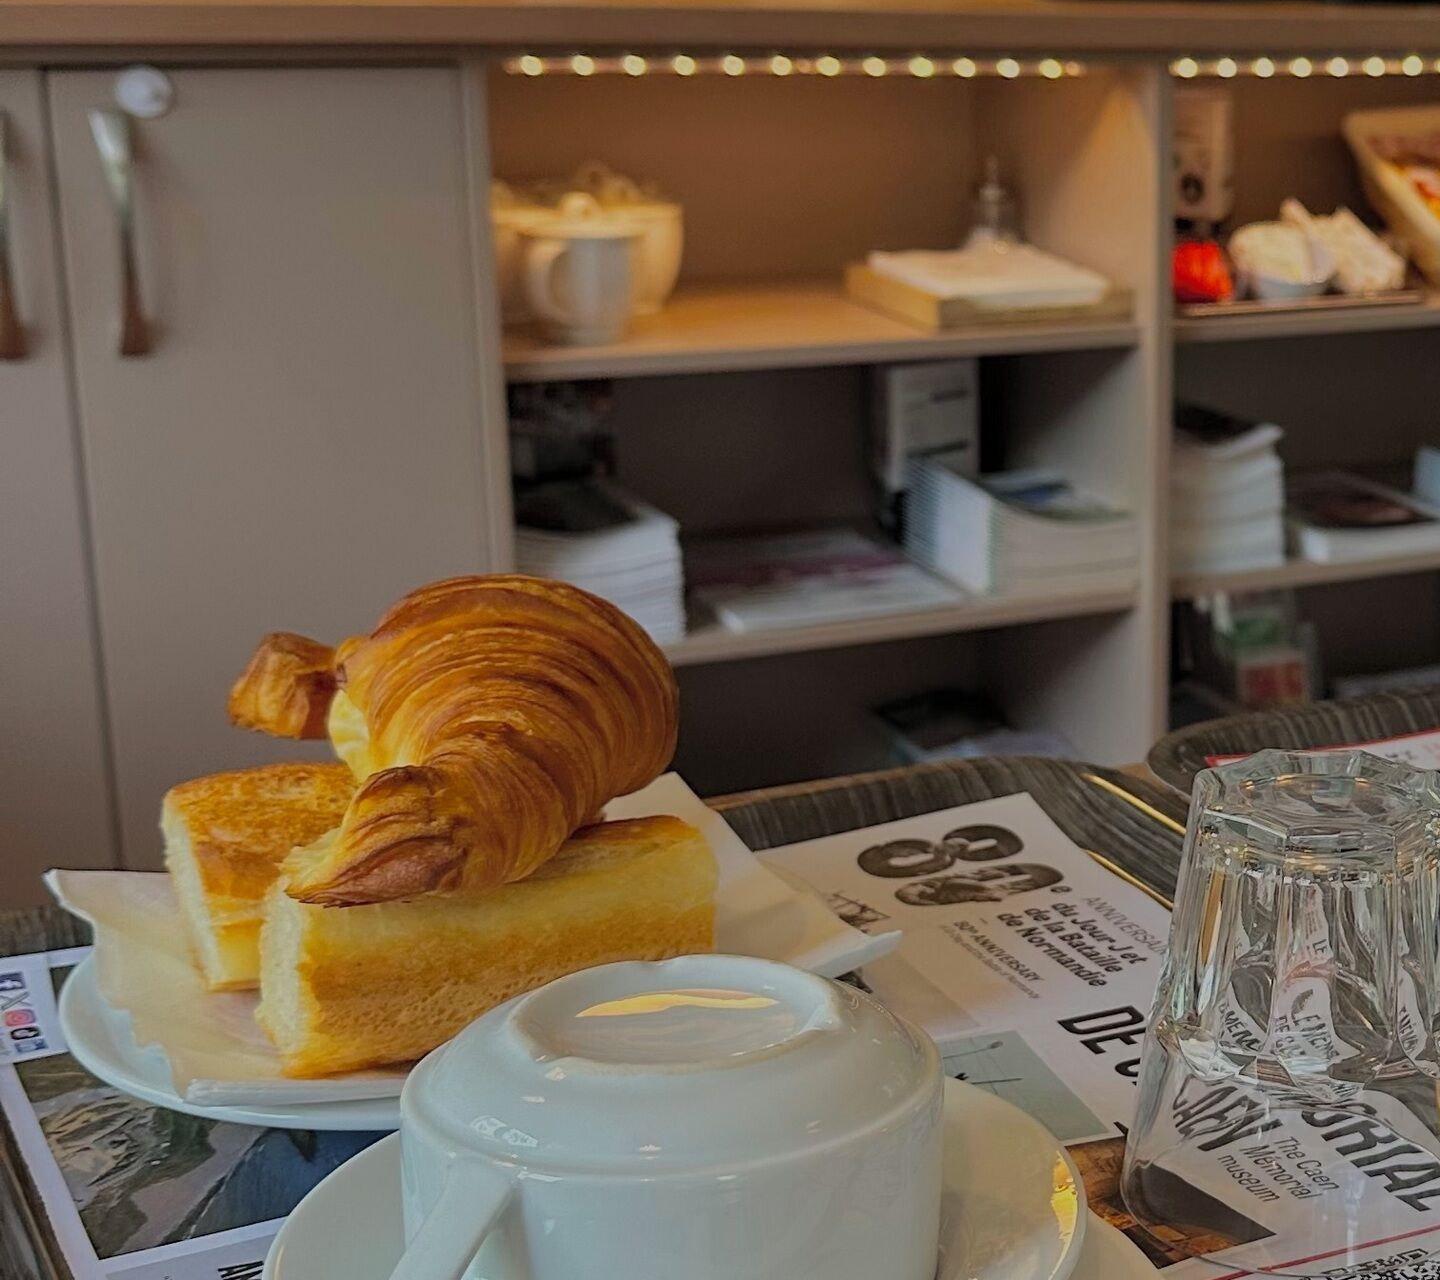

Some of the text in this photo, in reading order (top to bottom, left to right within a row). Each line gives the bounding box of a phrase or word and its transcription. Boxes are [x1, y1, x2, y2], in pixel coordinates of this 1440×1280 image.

[997, 913, 1023, 927] de
[1015, 926, 1108, 987] Normandie
[1023, 907, 1124, 974] de la Bataille
[1051, 902, 1148, 965] du Jour J et
[1083, 896, 1168, 956] ANNIVERSAI
[1217, 1154, 1281, 1204] museum
[1239, 1143, 1322, 1201] Mémorial
[1273, 1134, 1340, 1191] The Caen
